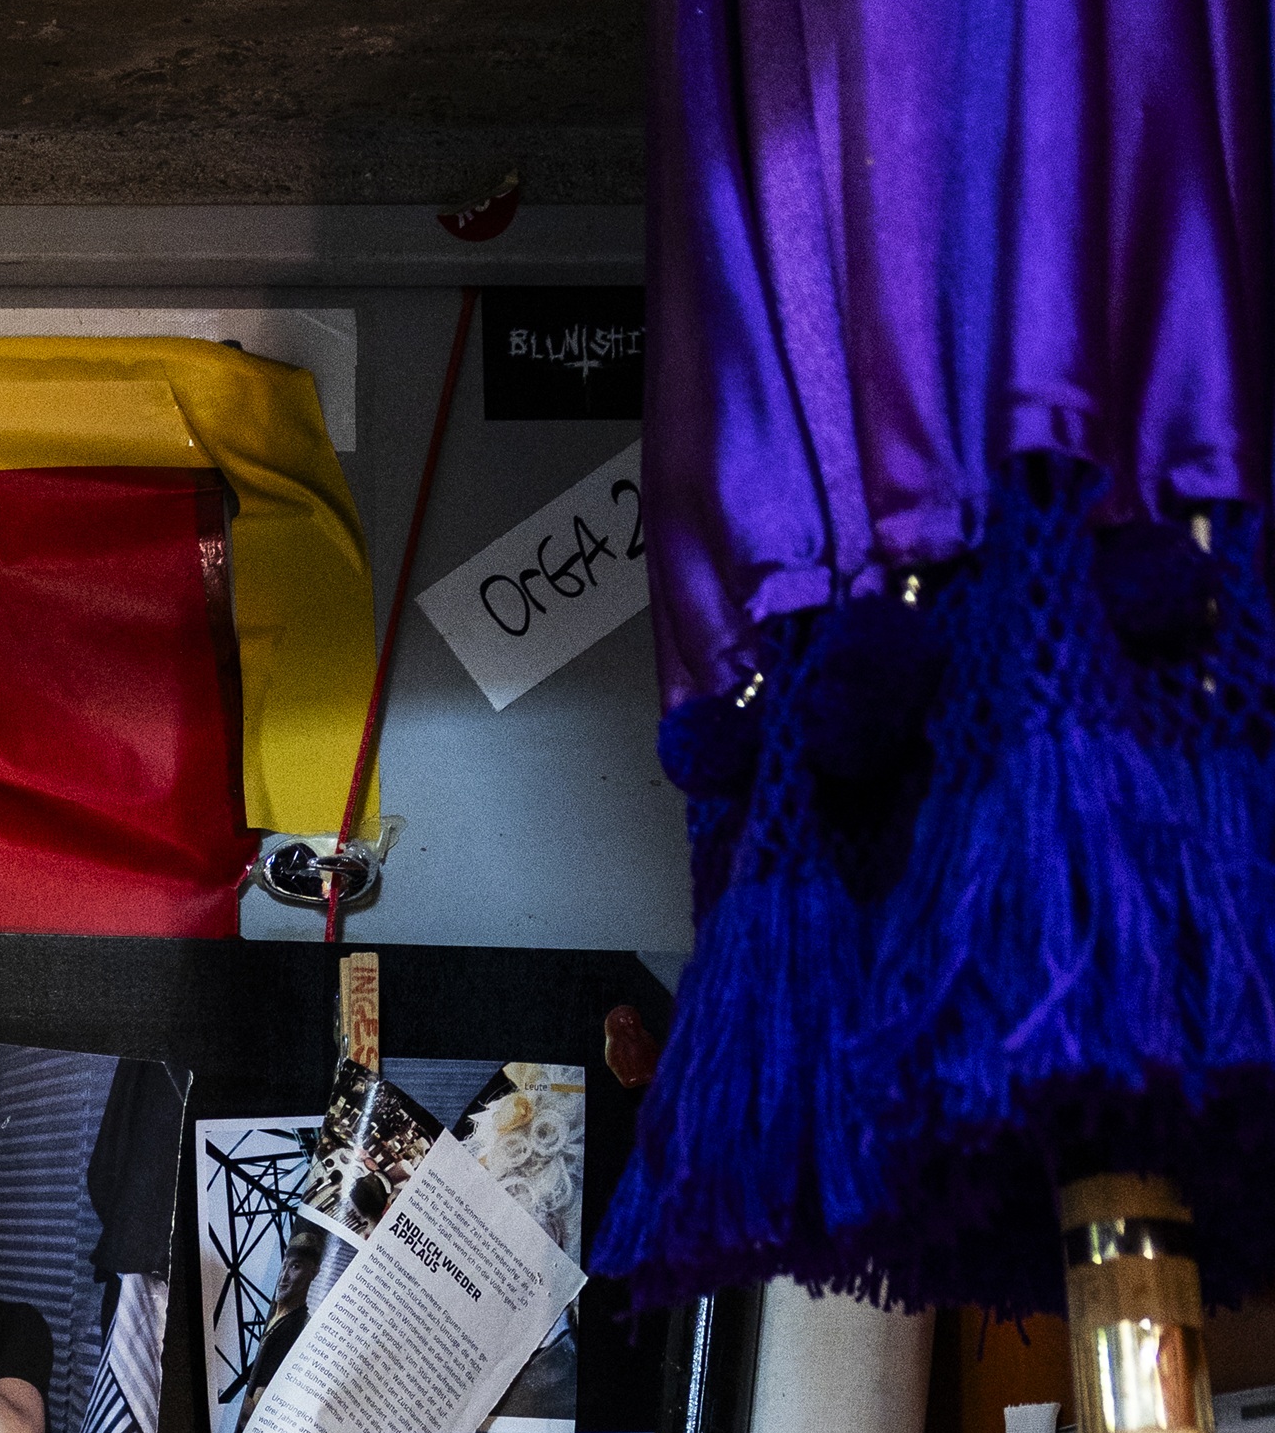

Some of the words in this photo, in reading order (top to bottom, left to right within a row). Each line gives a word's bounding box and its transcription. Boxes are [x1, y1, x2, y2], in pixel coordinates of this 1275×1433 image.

[387, 1218, 442, 1277] APPLAUS
[393, 1208, 445, 1263] ENDLICH
[438, 1254, 484, 1303] WIEDER
